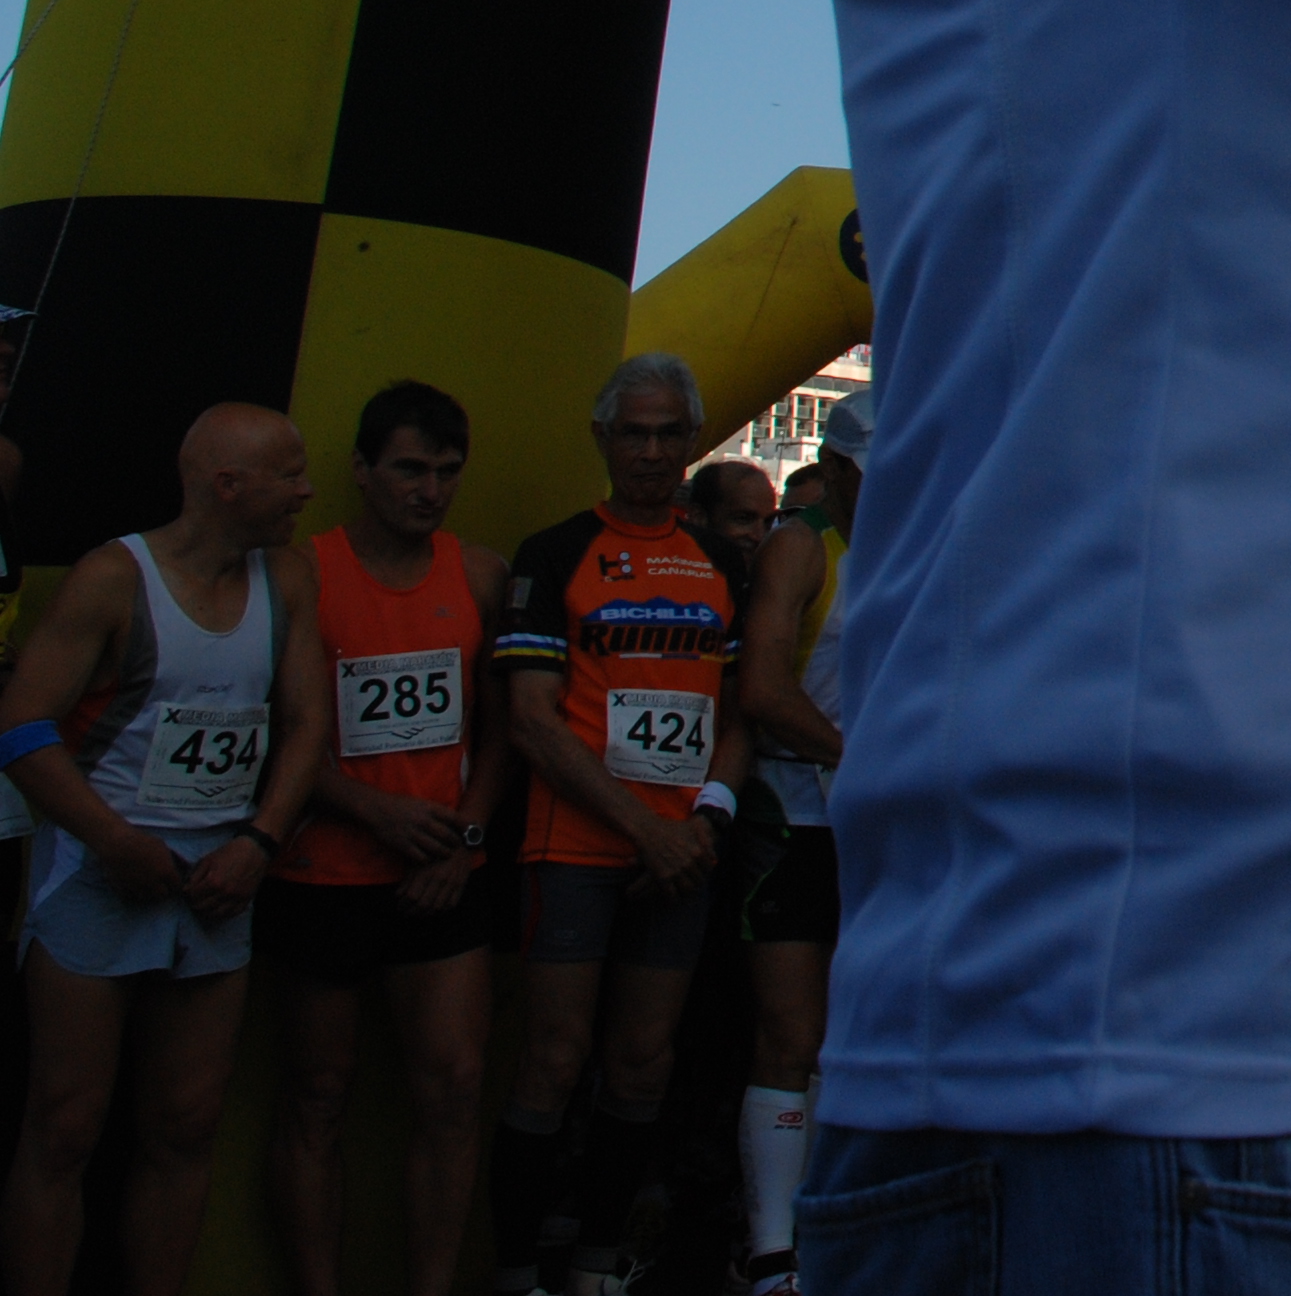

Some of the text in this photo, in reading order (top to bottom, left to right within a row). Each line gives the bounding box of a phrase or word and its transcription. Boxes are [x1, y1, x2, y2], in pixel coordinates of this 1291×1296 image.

[359, 671, 451, 723] 285
[169, 728, 258, 775] 434
[627, 710, 706, 756] 424
